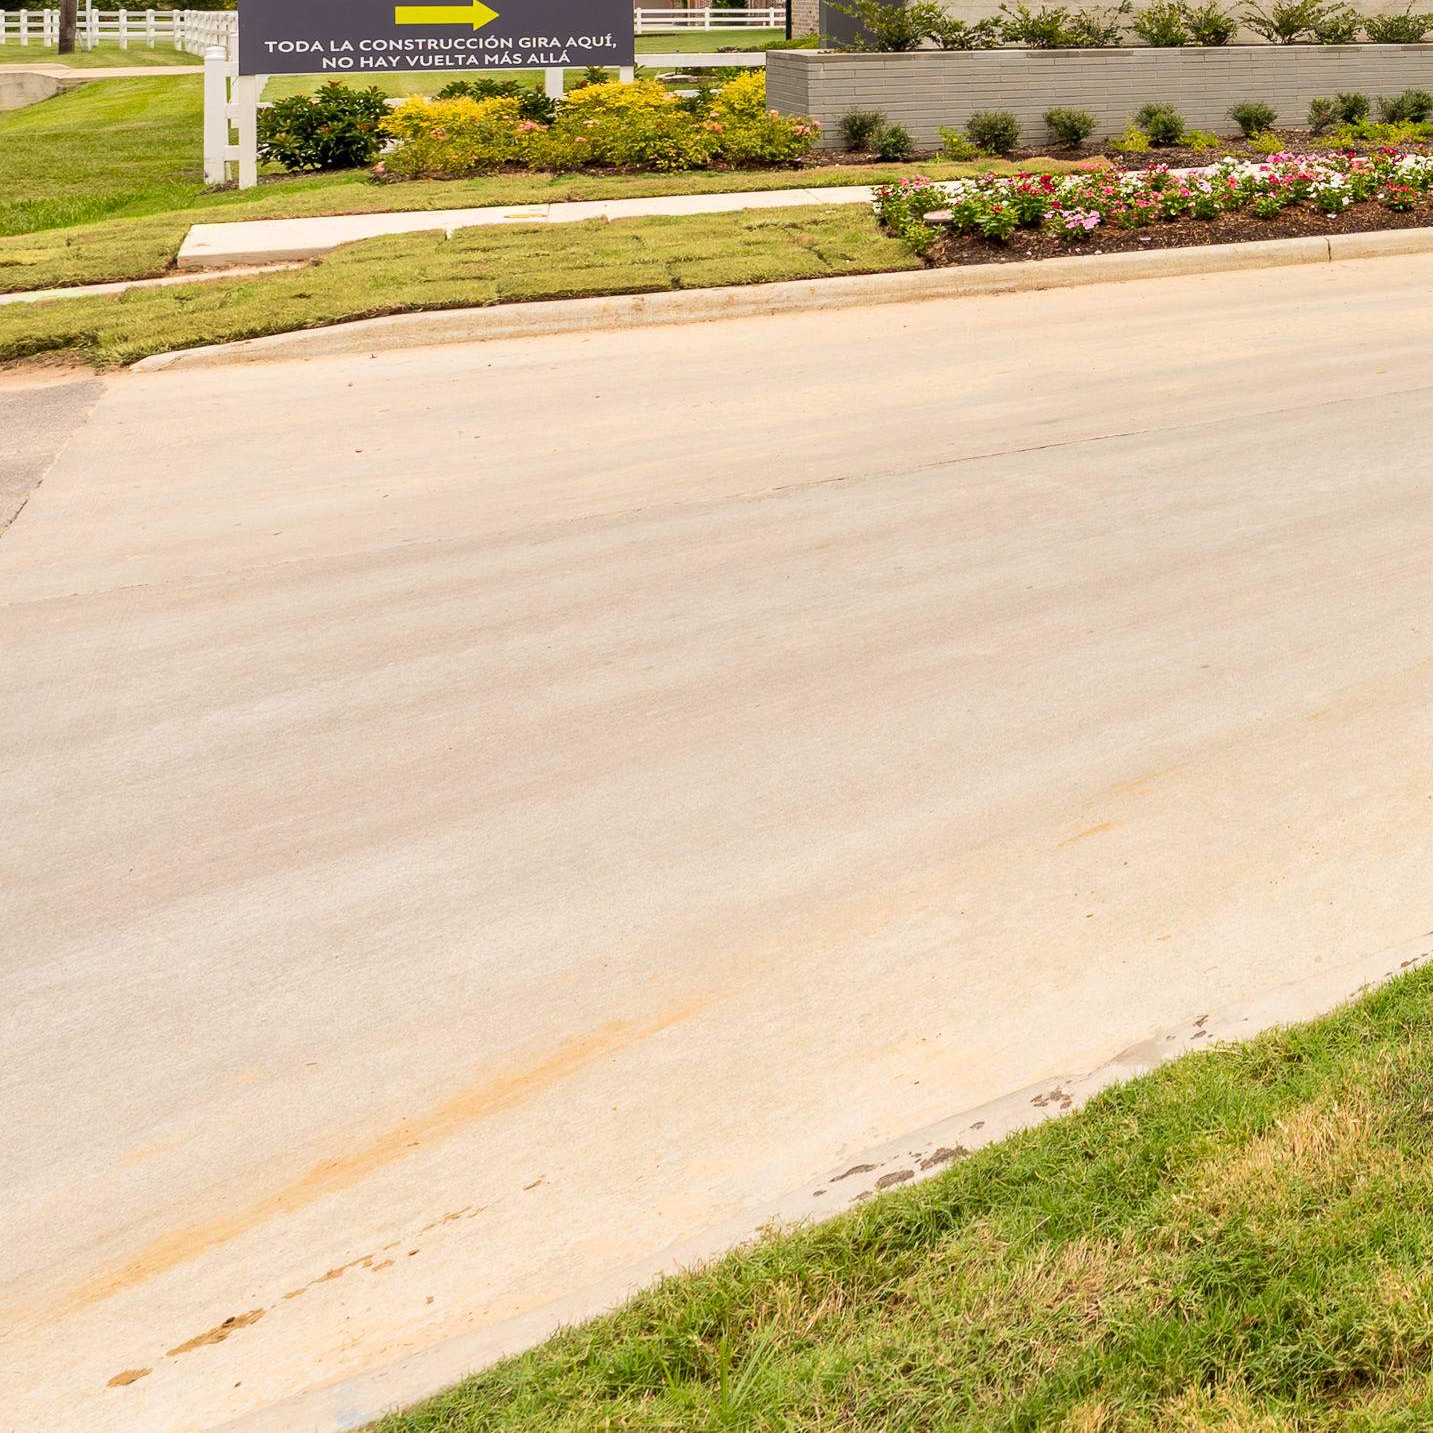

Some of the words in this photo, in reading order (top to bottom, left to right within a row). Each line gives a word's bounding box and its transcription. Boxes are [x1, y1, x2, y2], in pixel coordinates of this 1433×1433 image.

[264, 40, 324, 53] TODA
[330, 40, 354, 52] LA
[359, 35, 513, 52] CONSTRUCCIÓN
[518, 37, 561, 49] GIRA
[566, 33, 617, 50] AQUÍ,
[322, 56, 354, 69] NO
[360, 55, 401, 68] HAY
[405, 54, 479, 67] VUELTA
[484, 50, 523, 65] MÁS
[527, 49, 571, 64] ALLÁ
